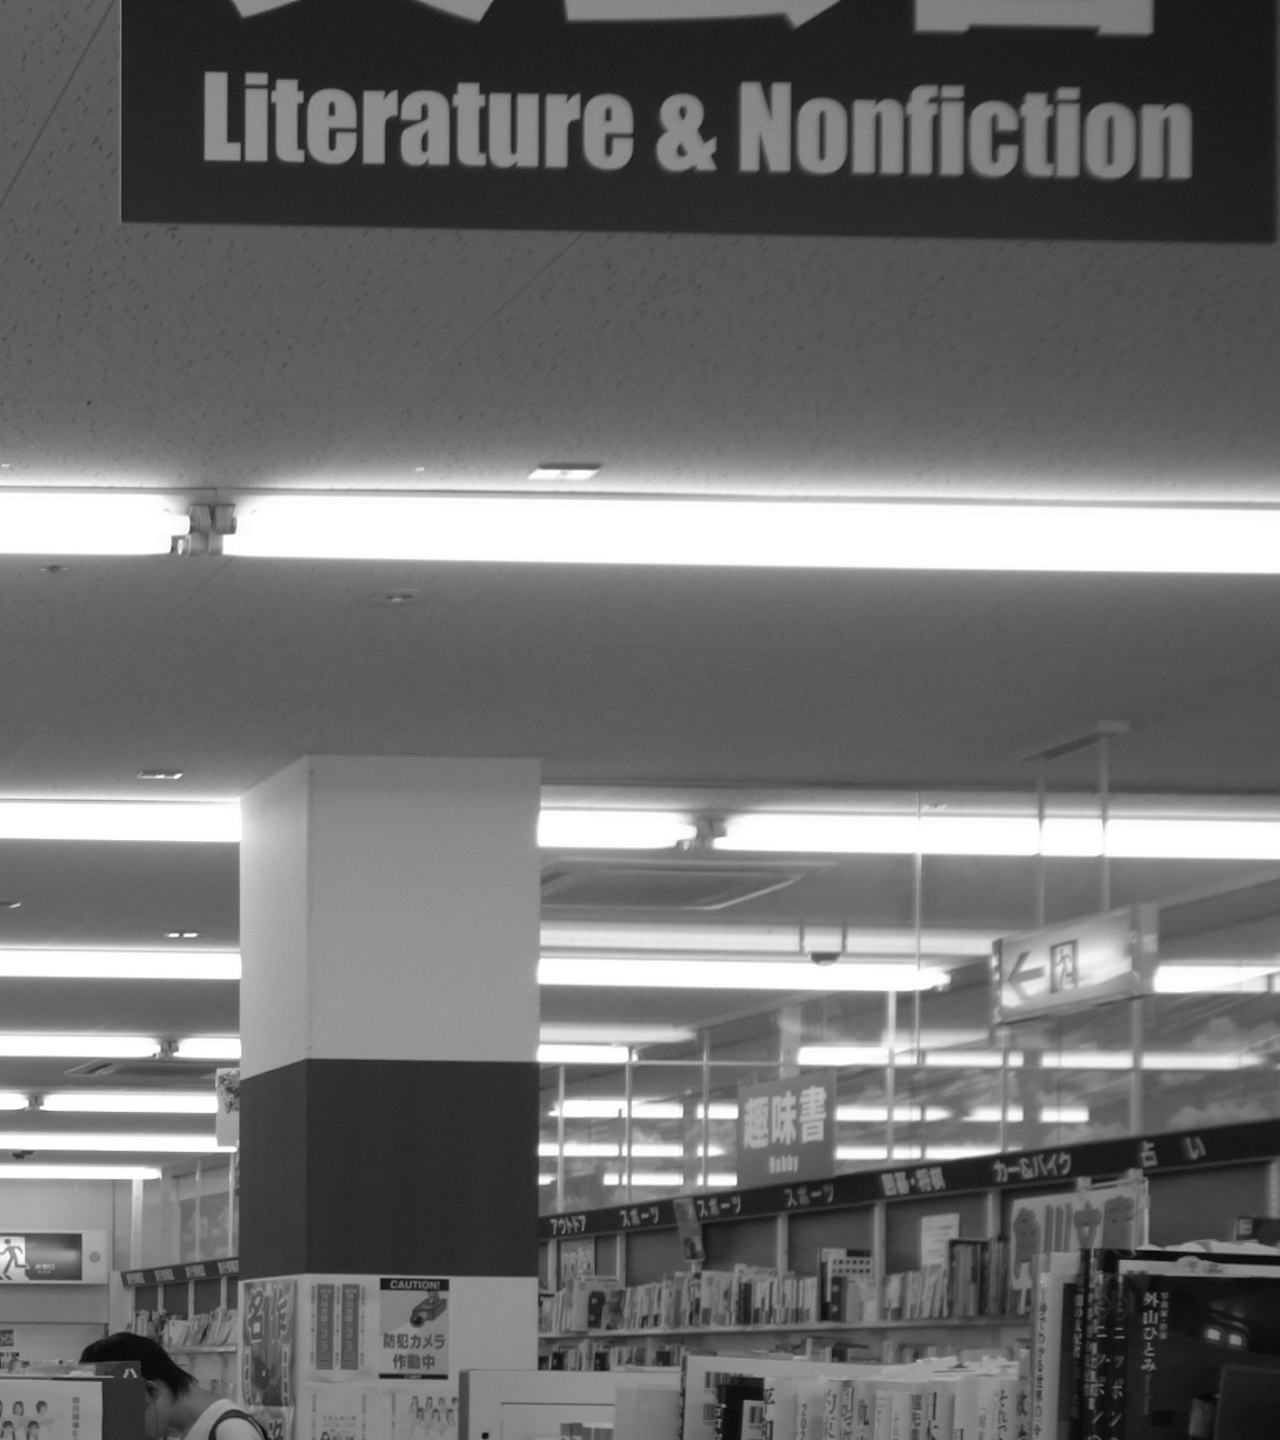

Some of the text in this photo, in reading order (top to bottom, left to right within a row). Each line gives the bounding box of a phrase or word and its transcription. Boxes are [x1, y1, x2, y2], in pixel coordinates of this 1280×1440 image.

[204, 70, 1194, 181] Literature & Nonfiction
[743, 1084, 827, 1151] 趣味書
[1138, 1136, 1207, 1167] 占い
[768, 1154, 799, 1175] Hobby
[696, 1194, 743, 1217] スポーツ
[784, 1184, 836, 1208] スポーツ
[620, 1205, 660, 1228] スポーツ
[388, 1279, 442, 1291] CAUTION!
[382, 1332, 447, 1352] 防犯カメラ
[1141, 1290, 1159, 1372] 外山ひとみ
[392, 1353, 437, 1373] 作動中
